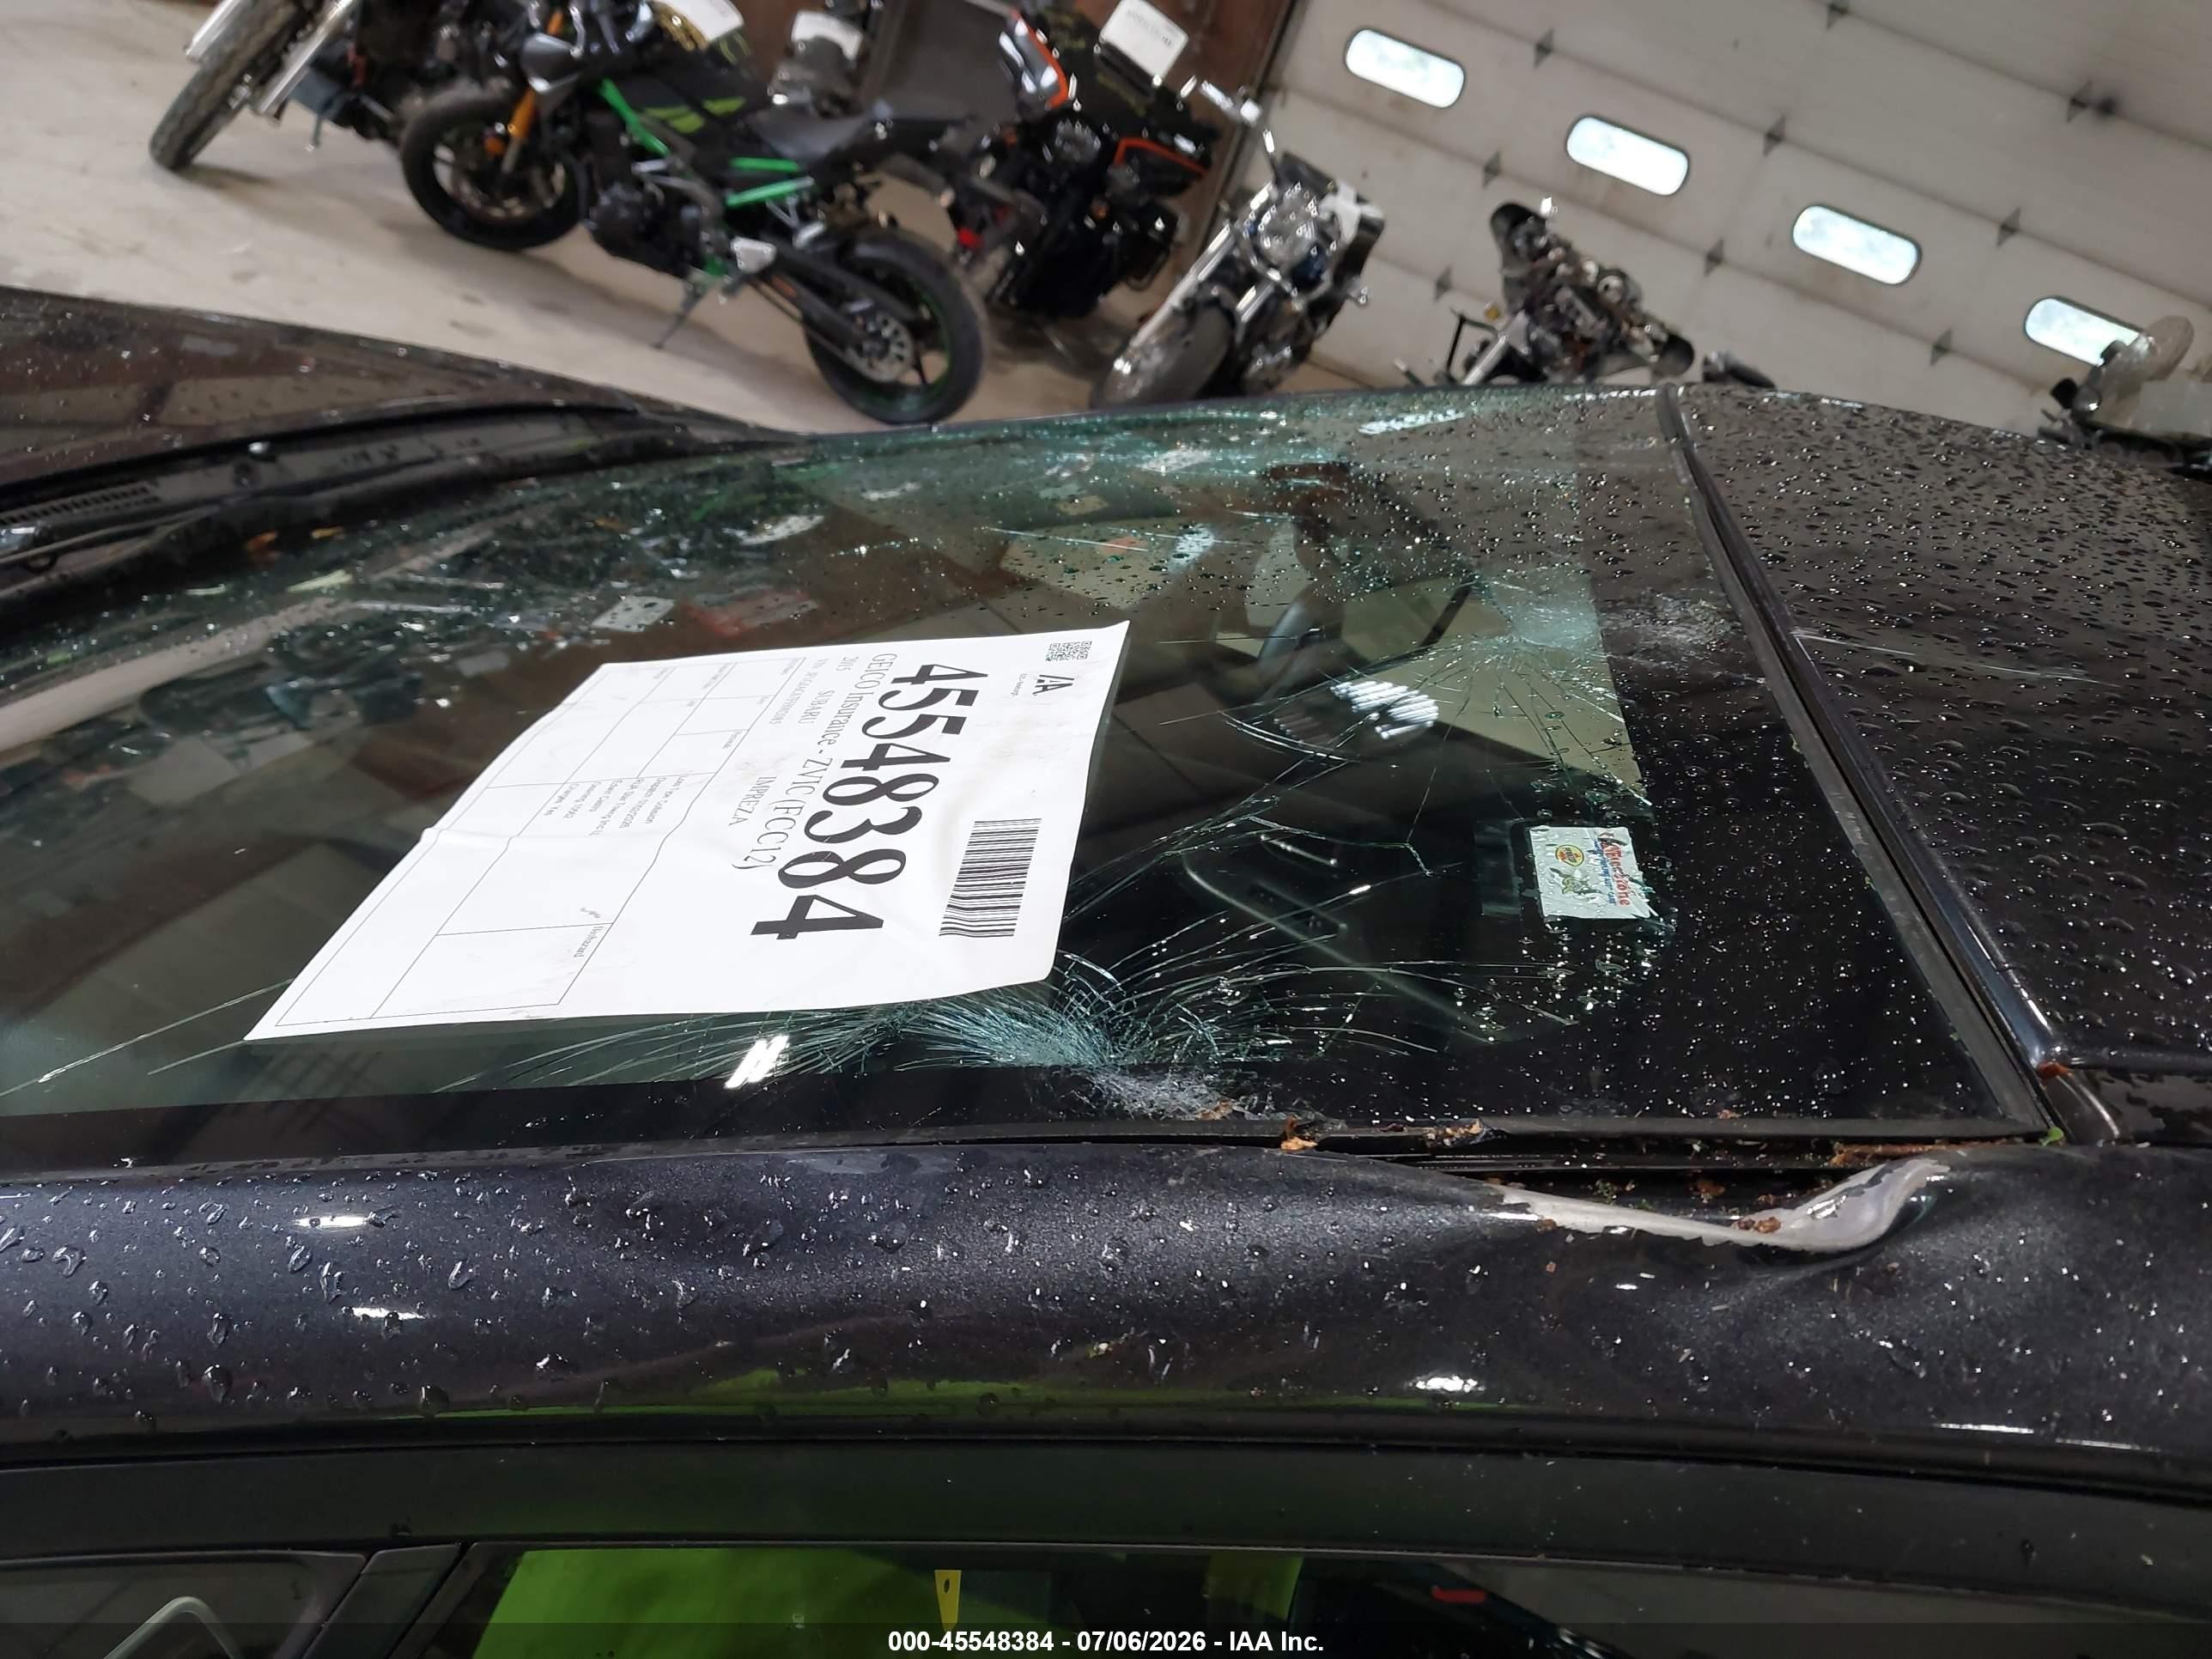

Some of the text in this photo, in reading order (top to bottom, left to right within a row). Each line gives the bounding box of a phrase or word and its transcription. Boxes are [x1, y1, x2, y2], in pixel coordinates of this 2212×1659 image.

[836, 656, 860, 672] 2015
[854, 653, 898, 690] GEICO
[798, 690, 836, 725] SUBARU
[817, 691, 874, 745] Insurance
[785, 757, 833, 795] ZVIC
[728, 776, 777, 826] IMPREZA
[750, 664, 988, 940] 45548384
[732, 799, 807, 870] (FCC12)
